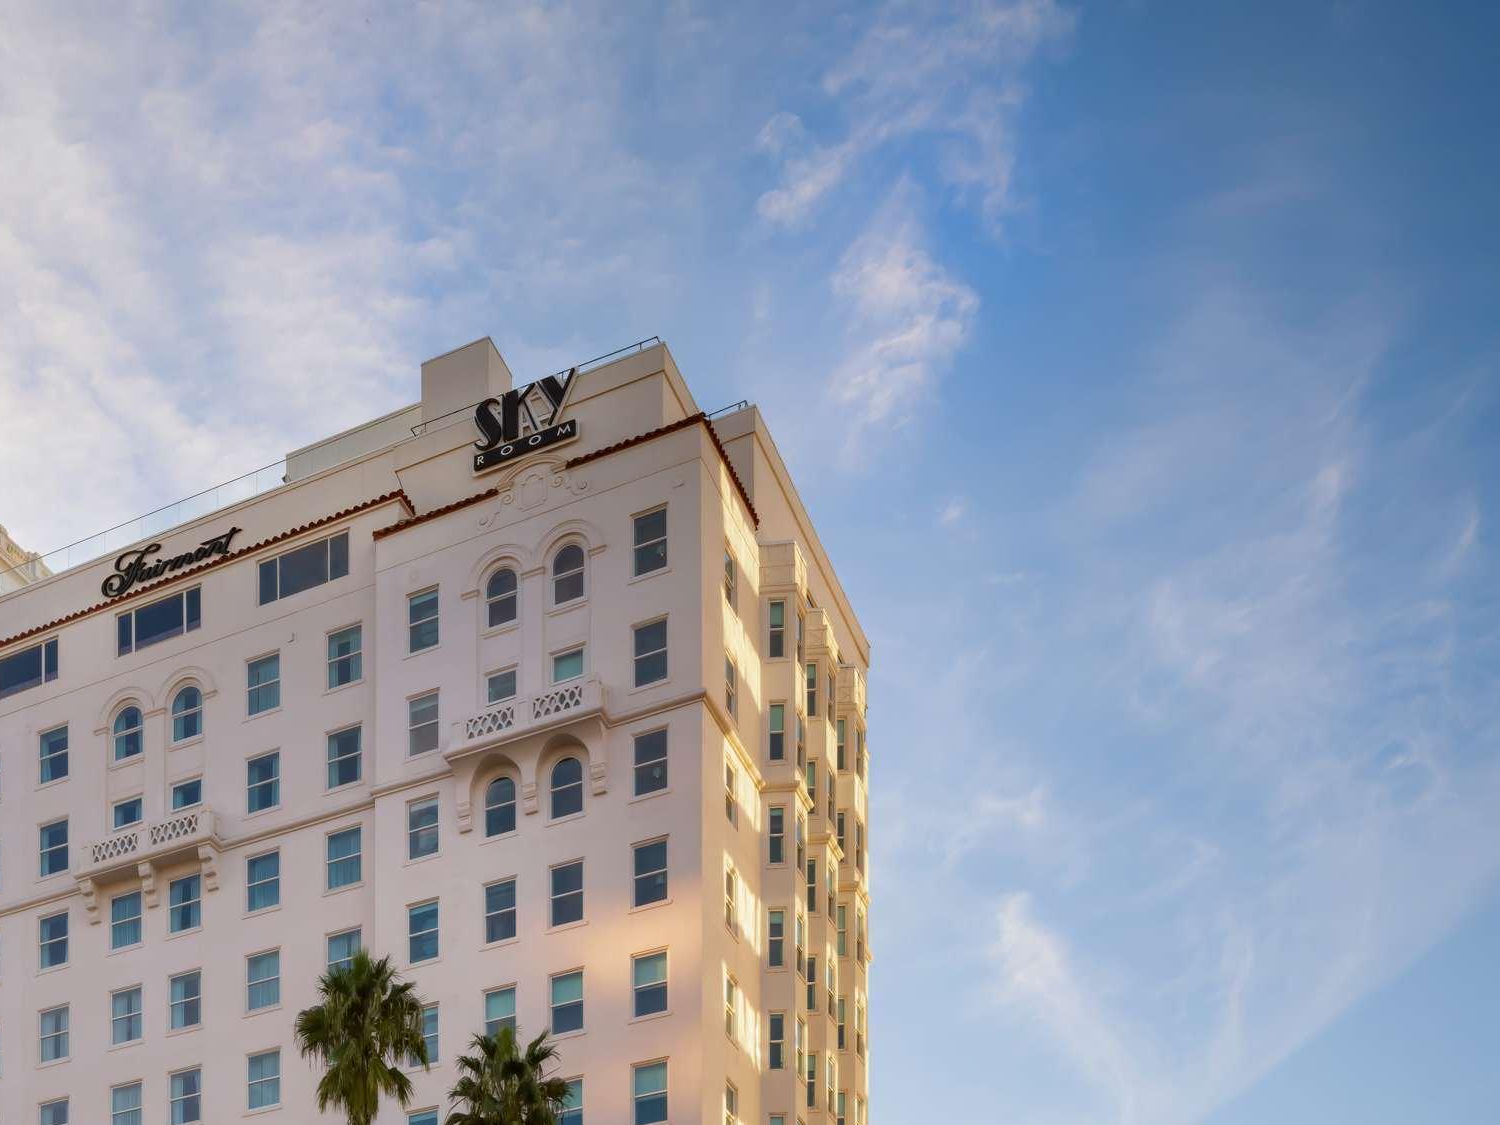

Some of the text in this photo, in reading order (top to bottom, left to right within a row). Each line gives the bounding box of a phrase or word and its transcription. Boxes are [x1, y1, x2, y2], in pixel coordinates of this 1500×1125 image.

[474, 368, 575, 451] SKY
[476, 424, 571, 466] ROOM
[102, 526, 242, 597] Fairmont
